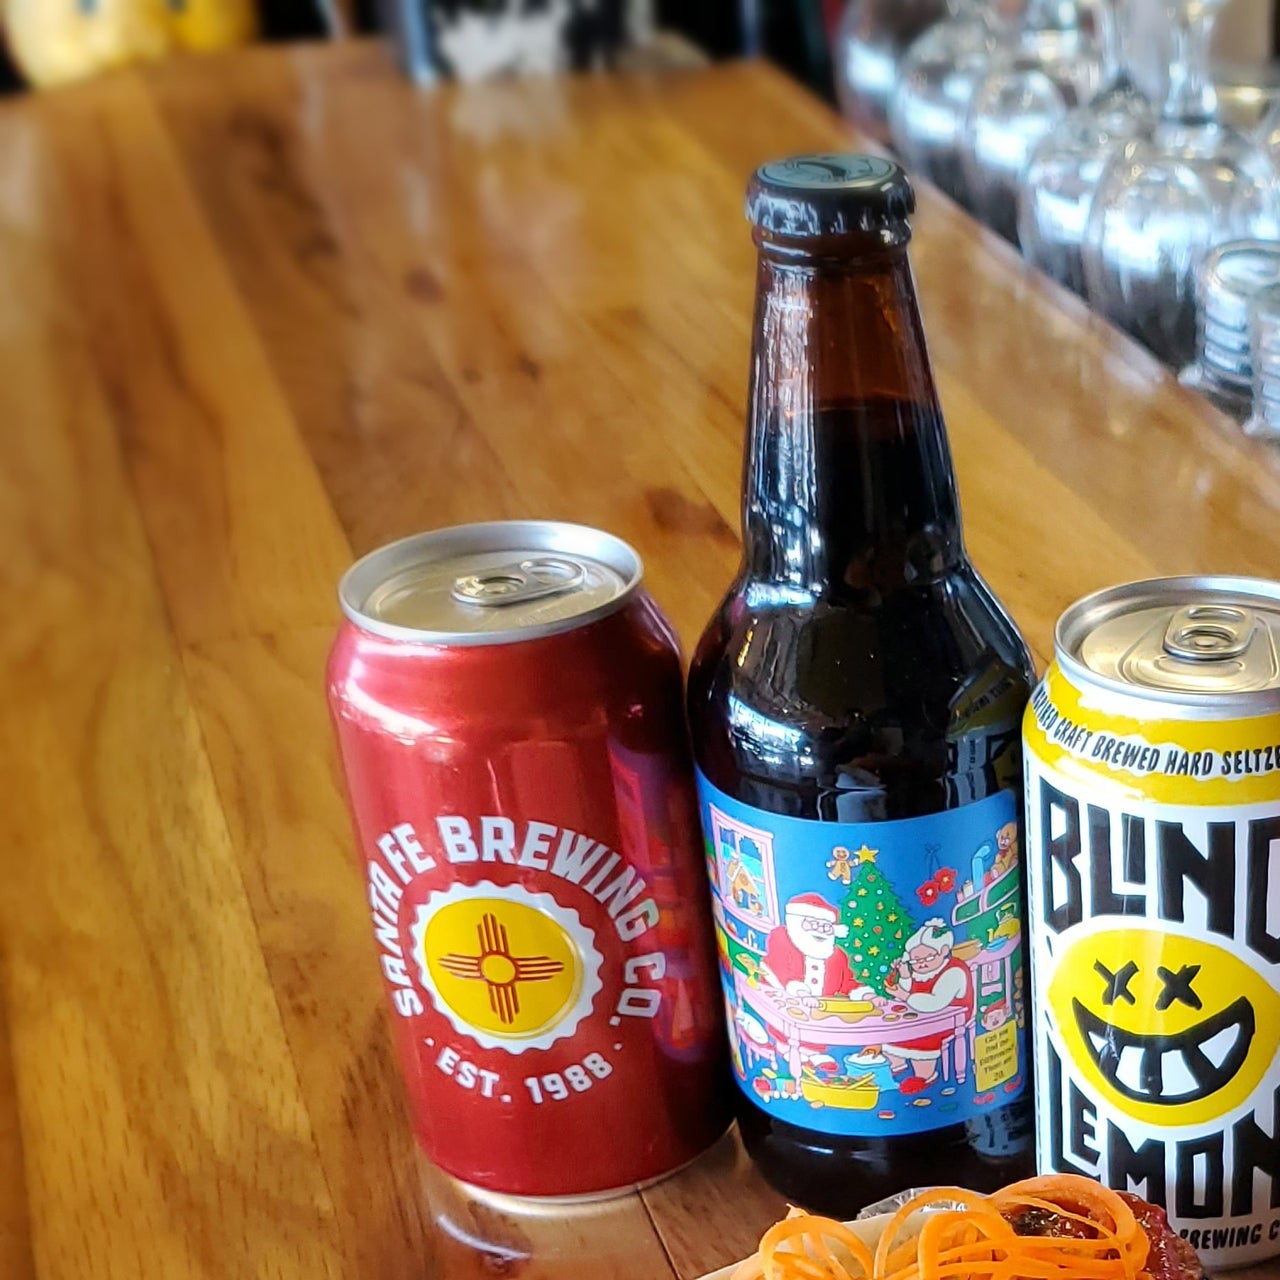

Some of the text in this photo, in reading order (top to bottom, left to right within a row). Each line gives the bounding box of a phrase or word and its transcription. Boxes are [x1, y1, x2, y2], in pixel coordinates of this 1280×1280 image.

[1054, 717, 1093, 753] CRAFT
[1092, 735, 1160, 772] BREWED
[1164, 751, 1213, 776] HARD
[368, 815, 667, 1027] SANTA FE BREWING CO.
[434, 1046, 613, 1105] EST. 1988
